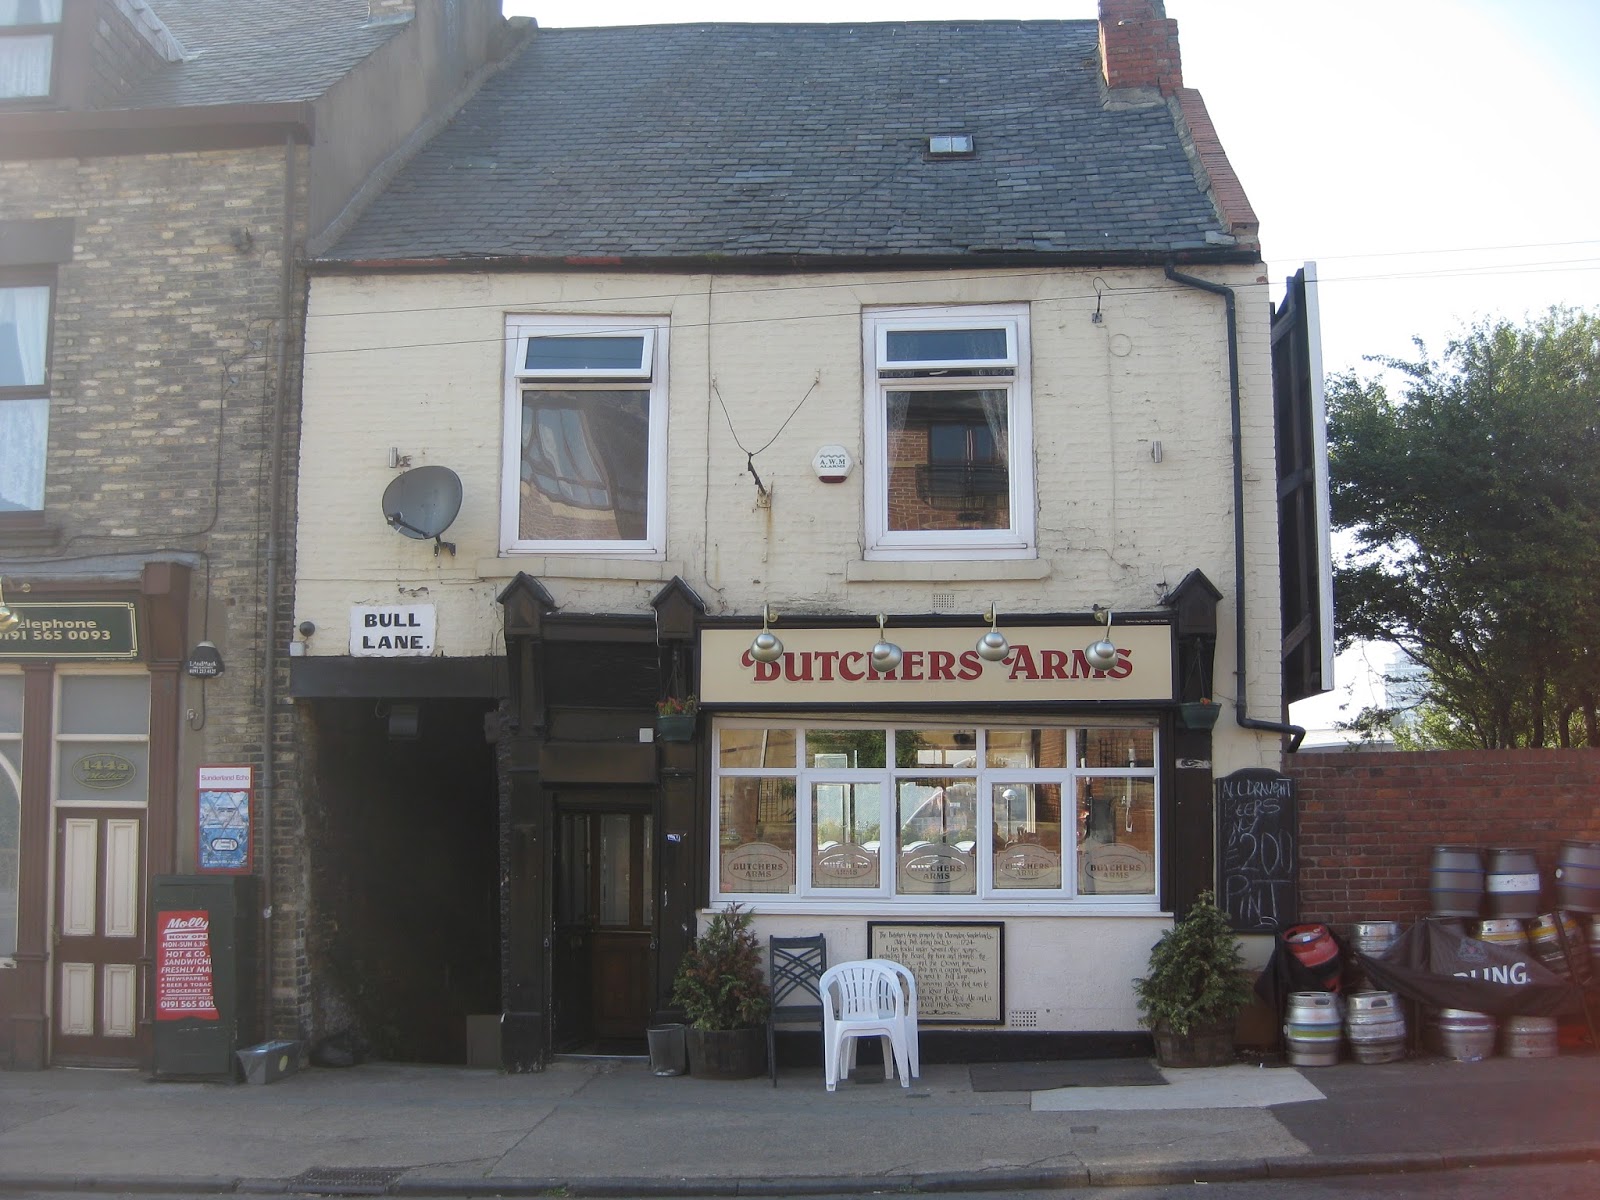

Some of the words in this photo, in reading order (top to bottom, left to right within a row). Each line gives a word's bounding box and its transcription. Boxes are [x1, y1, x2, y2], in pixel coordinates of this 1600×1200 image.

[18, 619, 97, 631] elephone
[364, 613, 421, 628] BULL
[33, 630, 62, 641] 565
[68, 630, 111, 641] 0093
[1001, 645, 1134, 681] ARMS
[923, 872, 950, 880] ARMS
